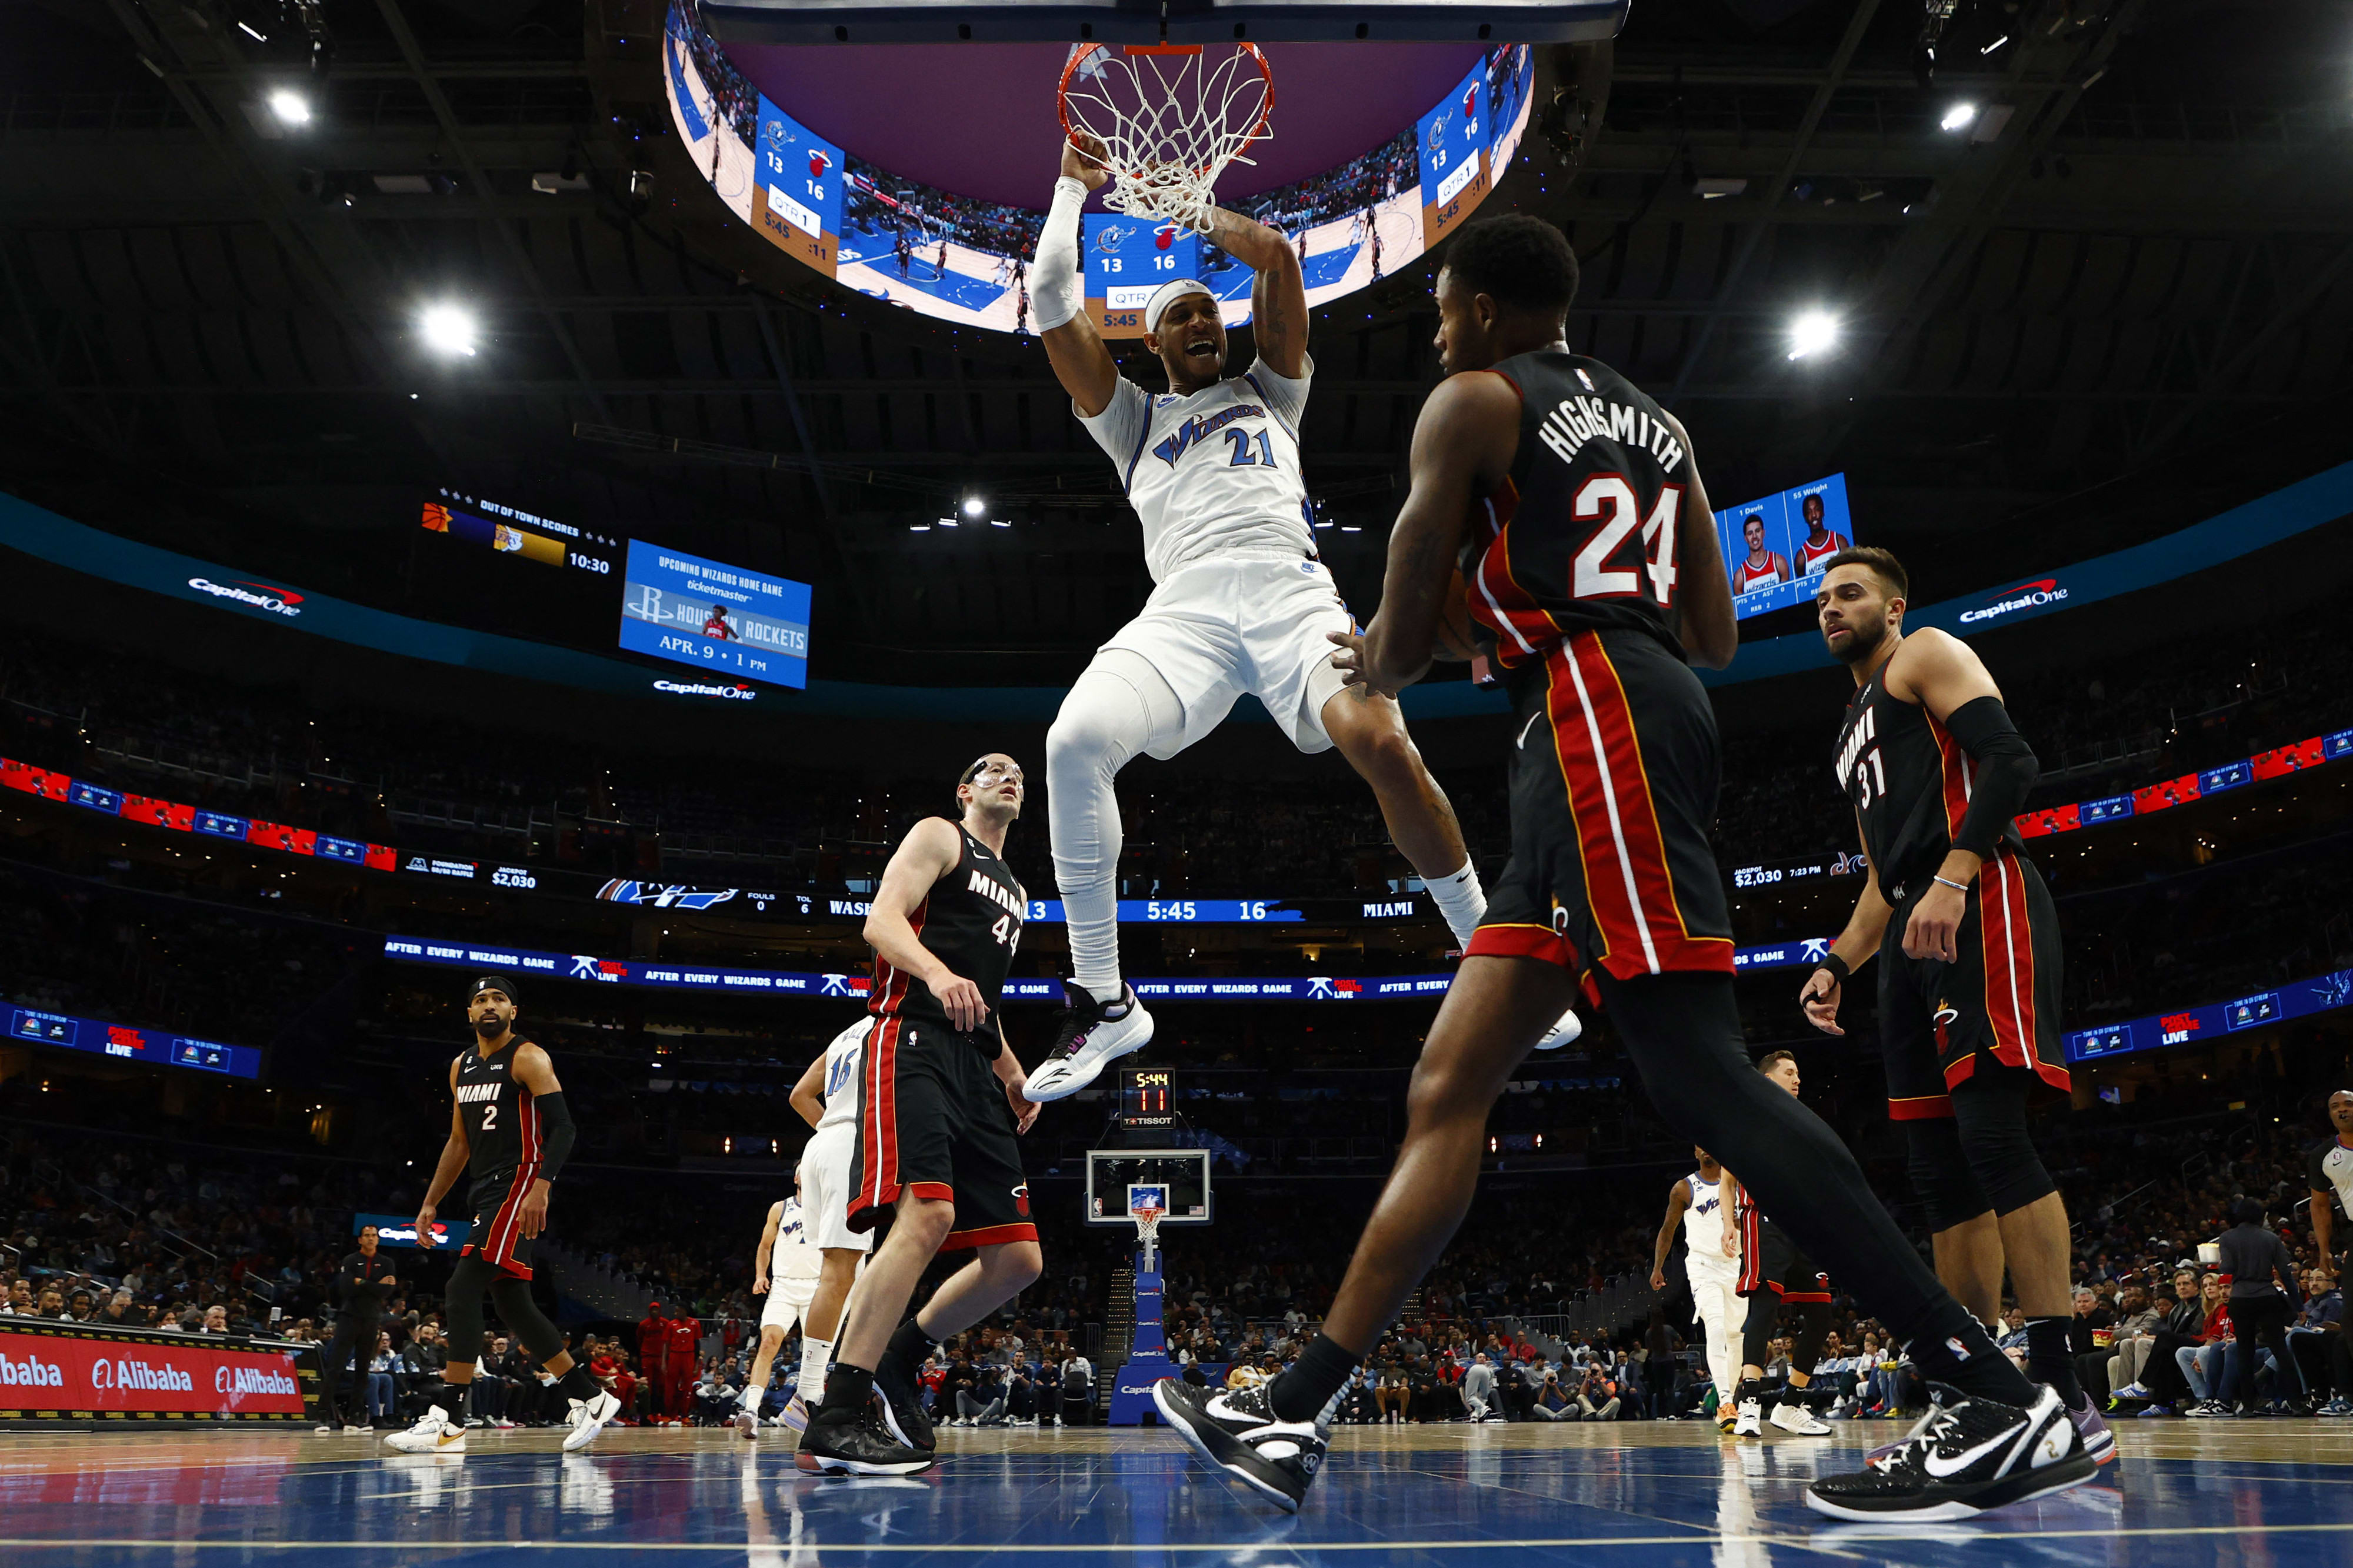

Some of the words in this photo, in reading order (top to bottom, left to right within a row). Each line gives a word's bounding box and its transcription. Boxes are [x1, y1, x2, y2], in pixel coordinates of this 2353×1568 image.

[1465, 117, 1478, 141] 16
[767, 151, 783, 174] 13
[1431, 149, 1447, 171] 13
[806, 179, 824, 201] 16
[1443, 172, 1464, 197] QTR
[1465, 166, 1470, 178] 1
[775, 196, 799, 218] QTR
[802, 215, 807, 226] 1
[1437, 200, 1459, 228] 5:45
[765, 212, 790, 238] 5:45
[1101, 258, 1122, 272] 13
[1154, 255, 1175, 270] 16
[1115, 293, 1146, 303] QTR
[1104, 314, 1137, 326] 5:45
[1538, 395, 1683, 473] HIGHSMITH
[1225, 428, 1278, 469] 21
[1793, 491, 1802, 499] 55
[1803, 483, 1828, 496] Wright
[480, 499, 500, 513] OUT
[501, 506, 514, 518] OF
[515, 509, 541, 526] TOWN
[542, 519, 579, 537] SCORES
[1745, 504, 1764, 515] Davis
[1569, 472, 1686, 608] 24
[569, 552, 610, 574] 10:30
[659, 556, 700, 576] UPCOMING
[702, 567, 737, 586] WIZARDS
[739, 577, 760, 592] HOME
[762, 582, 784, 597] GAME
[687, 579, 750, 602] ticketmaster
[1762, 589, 1774, 598] AST
[1751, 605, 1762, 613] REB
[745, 620, 805, 649] ROCKETS
[659, 636, 698, 656] APR.
[704, 646, 714, 659] 9
[736, 653, 743, 666] 1
[750, 659, 766, 671] PM
[1836, 706, 1875, 793] MIAMI
[1858, 745, 1885, 810] 31
[498, 867, 528, 876] JACKPOT
[1735, 866, 1762, 875] JACKPOT
[1735, 870, 1782, 888] $2,030
[1789, 868, 1807, 877] 7:23
[1809, 866, 1821, 874] PM
[492, 872, 536, 889] $2,030
[748, 892, 775, 900] FOULS
[757, 901, 765, 911] 0
[801, 903, 809, 914] 6
[1148, 901, 1196, 920] 5:45
[1239, 901, 1266, 919] 16
[1364, 902, 1413, 917] MIAMI
[992, 913, 1021, 957] 44
[385, 942, 422, 955] AFTER
[427, 946, 464, 959] EVERY
[469, 951, 518, 965] WIZARDS
[523, 958, 555, 969] GAME
[1754, 950, 1785, 963] GAME
[598, 973, 618, 982] LIVE
[645, 971, 679, 982] AFTER
[684, 974, 718, 984] EVERY
[724, 976, 771, 986] WIZARDS
[775, 979, 806, 989] GAME
[1379, 983, 1411, 993] AFTER
[1417, 980, 1449, 990] EVERY
[848, 989, 868, 997] LIVE
[1019, 985, 1049, 993] GAME
[1137, 984, 1172, 993] AFTER
[1174, 984, 1207, 993] EVERY
[1212, 984, 1258, 993] WIZARDS
[1262, 984, 1292, 993] GAME
[1334, 990, 1354, 999] LIVE
[2160, 1013, 2191, 1027] POST
[2162, 1030, 2189, 1045] LIVE
[105, 1043, 133, 1057] LIVE
[826, 1048, 859, 1097] 16
[1136, 1073, 1168, 1087] 5:44
[457, 1083, 502, 1104] MIAMI
[1142, 1090, 1165, 1111] 11
[482, 1105, 498, 1130] 2
[118, 1360, 193, 1391] Alibaba
[235, 1367, 295, 1394] Alibaba
